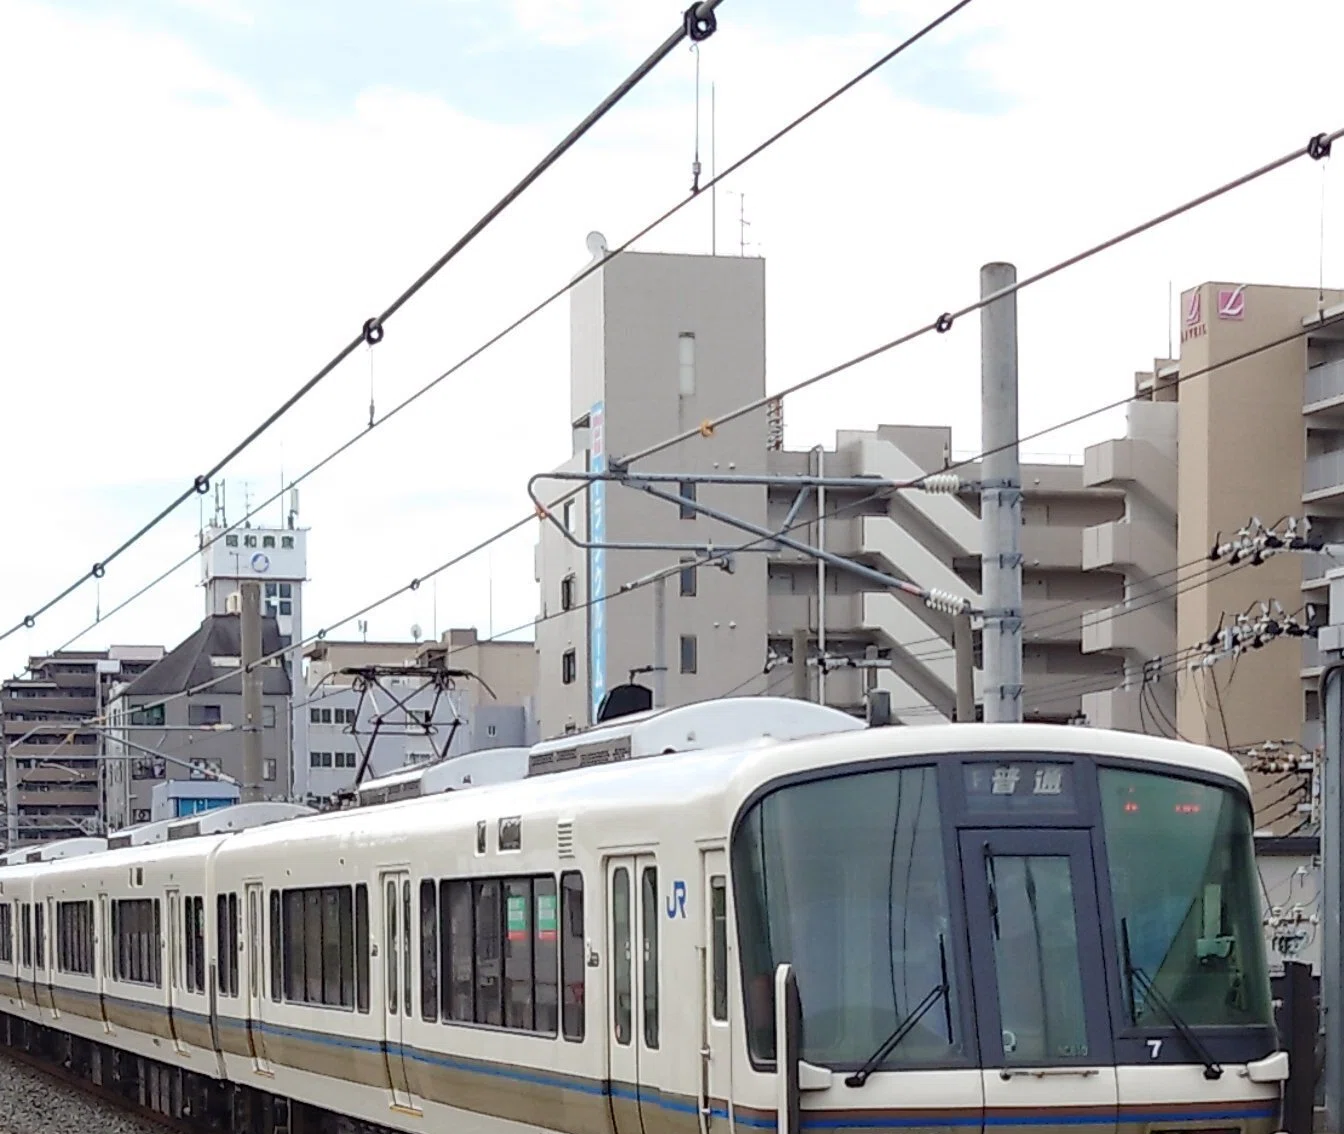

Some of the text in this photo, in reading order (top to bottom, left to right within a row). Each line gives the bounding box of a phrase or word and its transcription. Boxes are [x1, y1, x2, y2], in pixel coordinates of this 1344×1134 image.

[991, 765, 1062, 795] 普通
[666, 880, 687, 919] JR
[1147, 1040, 1162, 1058] 7
